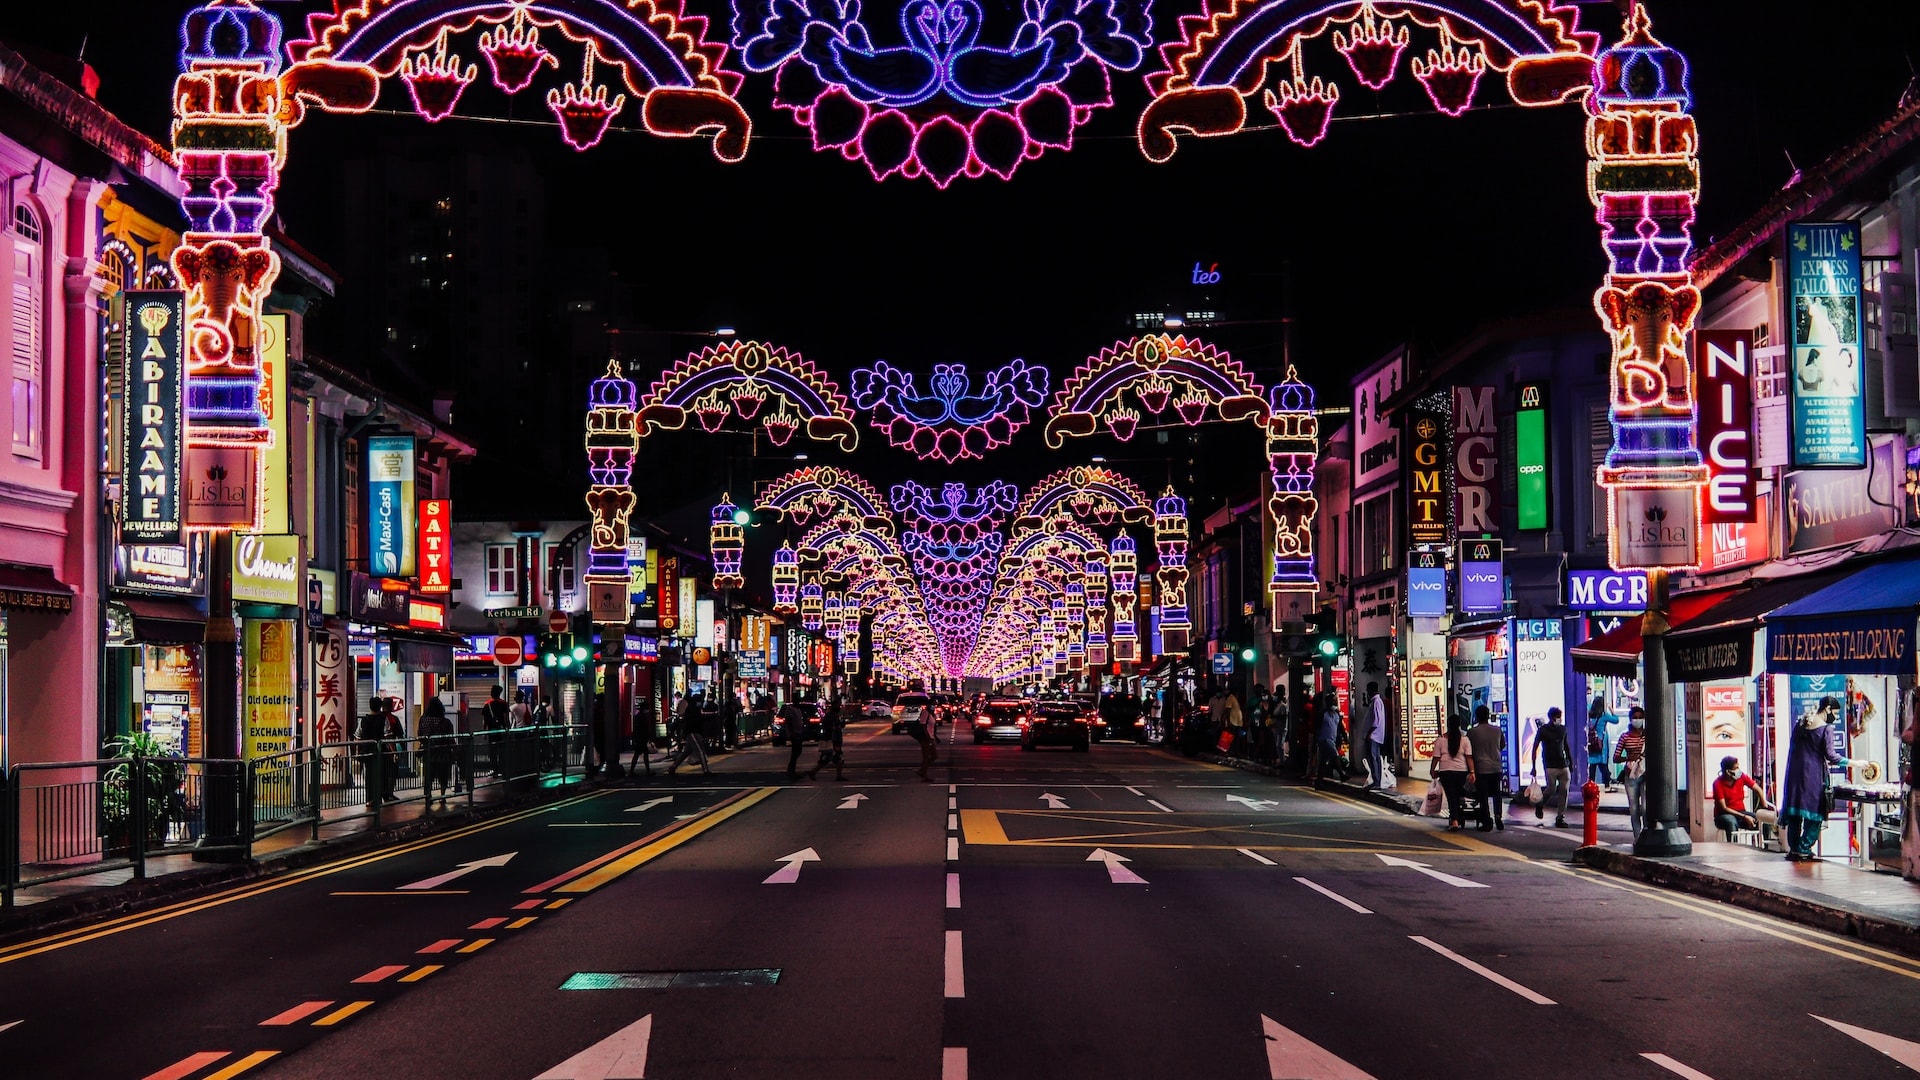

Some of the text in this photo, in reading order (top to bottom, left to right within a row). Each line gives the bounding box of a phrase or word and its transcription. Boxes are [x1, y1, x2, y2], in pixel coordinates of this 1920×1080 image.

[1809, 229, 1839, 258] LILY
[1800, 260, 1849, 276] EXPRESS
[1794, 278, 1857, 294] TAILORING
[139, 338, 166, 519] ABIRAME
[1707, 341, 1748, 512] NICE
[1456, 387, 1499, 532] MGR
[1519, 464, 1544, 474] oppo
[1413, 443, 1442, 521] GMT
[189, 479, 246, 502] Lisha
[1802, 474, 1872, 529] SAKTHI
[123, 521, 179, 531] JEWELLERS
[379, 487, 392, 551] Maxi-Cash
[1627, 522, 1687, 543] Lisha
[1712, 522, 1747, 554] NICE
[426, 501, 442, 585] SATYA
[237, 536, 297, 582] Chennai
[1466, 573, 1498, 583] vivo
[1411, 582, 1442, 591] vivo
[1570, 576, 1648, 605] MGR
[487, 607, 539, 617] Kerbau Rd
[1516, 620, 1561, 635] MGR
[319, 638, 341, 662] 75
[1772, 629, 1906, 661] LILY EXPRESS TAILORING
[1519, 651, 1547, 662] OPPO
[1519, 664, 1537, 673] A94
[1414, 679, 1442, 696] 0%
[1458, 683, 1473, 695] 5G
[247, 695, 261, 705] Old
[262, 695, 281, 705] Gold
[1707, 690, 1743, 703] NICE
[250, 727, 293, 737] EXCHANGE
[256, 742, 287, 752] REPAIR
[1420, 744, 1436, 752] GM
